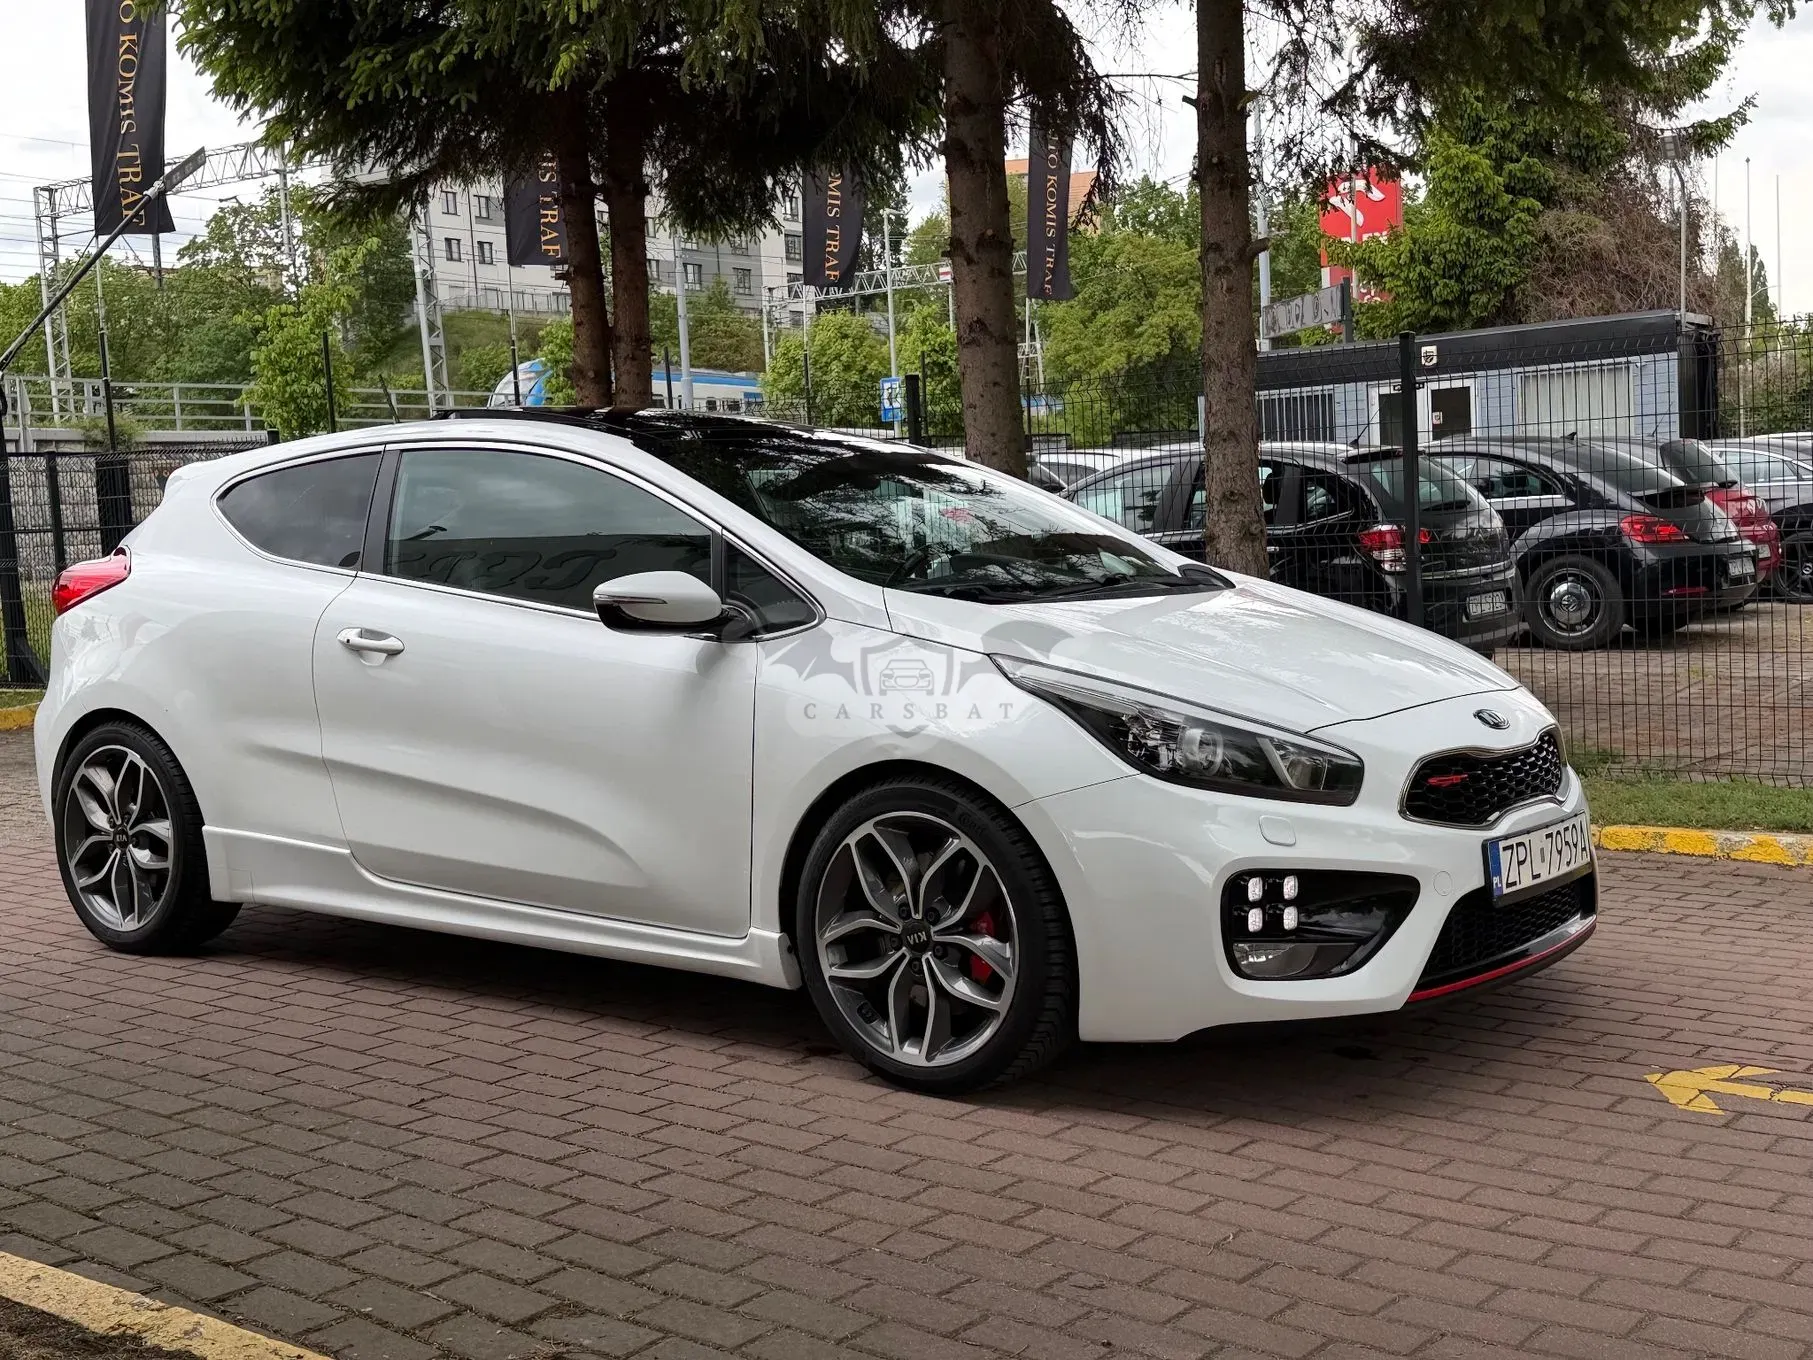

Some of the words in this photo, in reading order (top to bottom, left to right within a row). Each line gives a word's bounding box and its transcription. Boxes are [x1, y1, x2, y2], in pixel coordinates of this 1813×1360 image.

[118, 32, 138, 134] KOMIS
[540, 190, 561, 259] TRAF
[826, 172, 842, 218] MIS
[1046, 175, 1058, 238] KOMIS
[824, 224, 841, 283] TRAF
[1492, 876, 1502, 889] PL
[1502, 838, 1541, 889] ZPL
[1545, 818, 1589, 875] 7959A
